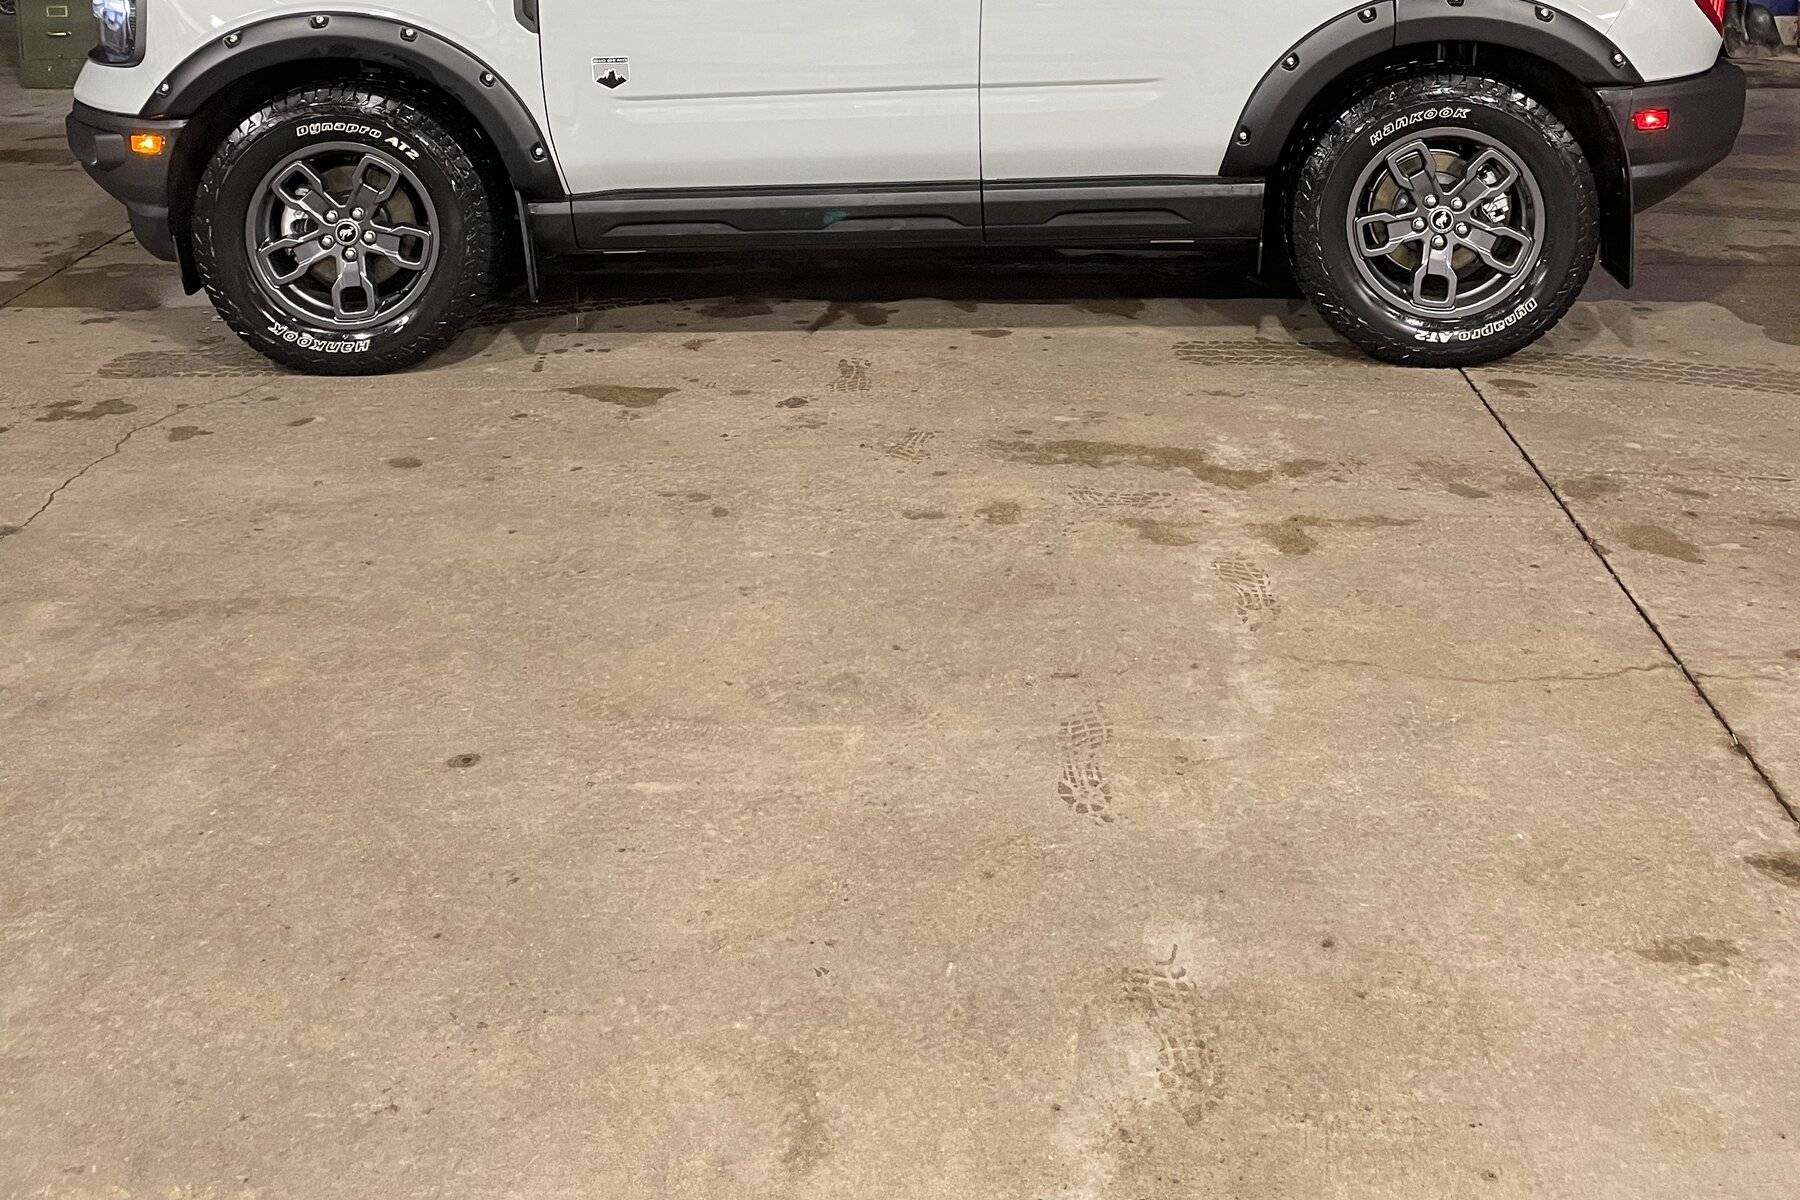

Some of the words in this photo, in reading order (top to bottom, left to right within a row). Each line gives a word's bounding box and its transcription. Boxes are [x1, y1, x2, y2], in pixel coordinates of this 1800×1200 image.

[296, 122, 382, 138] Dynapro
[384, 136, 420, 160] AT2
[1414, 329, 1454, 343] AT2
[1458, 297, 1538, 341] Dynapro
